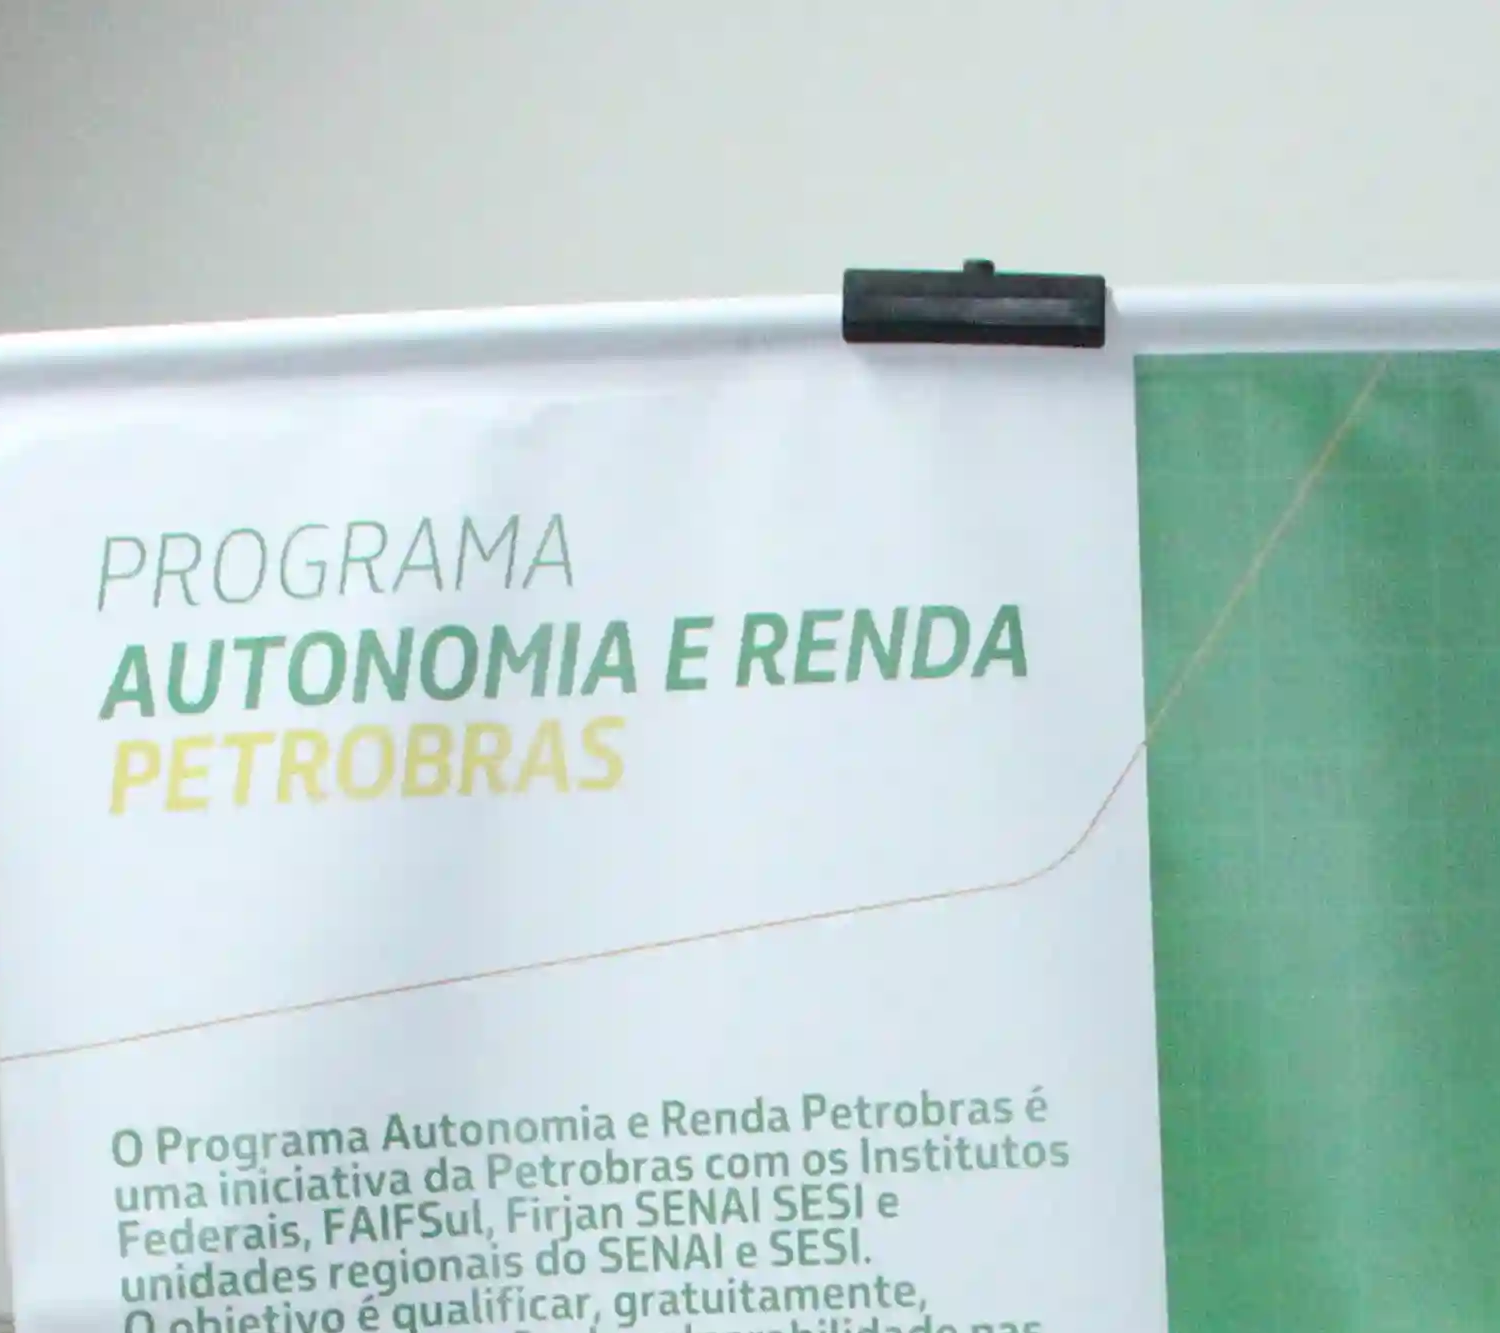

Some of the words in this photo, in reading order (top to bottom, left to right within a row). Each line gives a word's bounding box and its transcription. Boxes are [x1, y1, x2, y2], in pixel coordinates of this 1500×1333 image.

[96, 512, 575, 613] PROGRAMA
[98, 617, 636, 720] AUTONOMIA
[665, 614, 715, 693] E
[736, 603, 1030, 687] RENDA
[108, 715, 627, 815] PETROBRAS
[112, 1130, 142, 1167] O
[158, 1127, 369, 1171] Programa
[382, 1105, 615, 1151] Autonomia
[629, 1113, 648, 1138] e
[663, 1096, 790, 1136] Renda
[803, 1090, 1012, 1131] Petrobras
[1026, 1087, 1046, 1121] é
[116, 1183, 207, 1212] uma
[220, 1162, 412, 1205] iniciativa
[424, 1156, 474, 1193] da
[488, 1148, 693, 1191] Petrobras
[706, 1152, 789, 1180] com
[803, 1149, 847, 1176] os
[861, 1135, 1068, 1174] Institutos
[119, 1213, 310, 1258] Federais,
[324, 1199, 497, 1242] FAIFSul,
[508, 1197, 622, 1241] Firjan
[636, 1187, 760, 1227] SENAI
[774, 1183, 862, 1222] SESI
[878, 1193, 898, 1218] e
[122, 1257, 316, 1302] unidades
[330, 1253, 523, 1297] regionais
[536, 1240, 585, 1276] do
[599, 1233, 722, 1273] SENAI
[737, 1242, 756, 1268] e
[770, 1228, 871, 1266] SESI.
[358, 1295, 379, 1331] é
[393, 1287, 600, 1333] qualificar,
[615, 1276, 925, 1328] gratuitamente,
